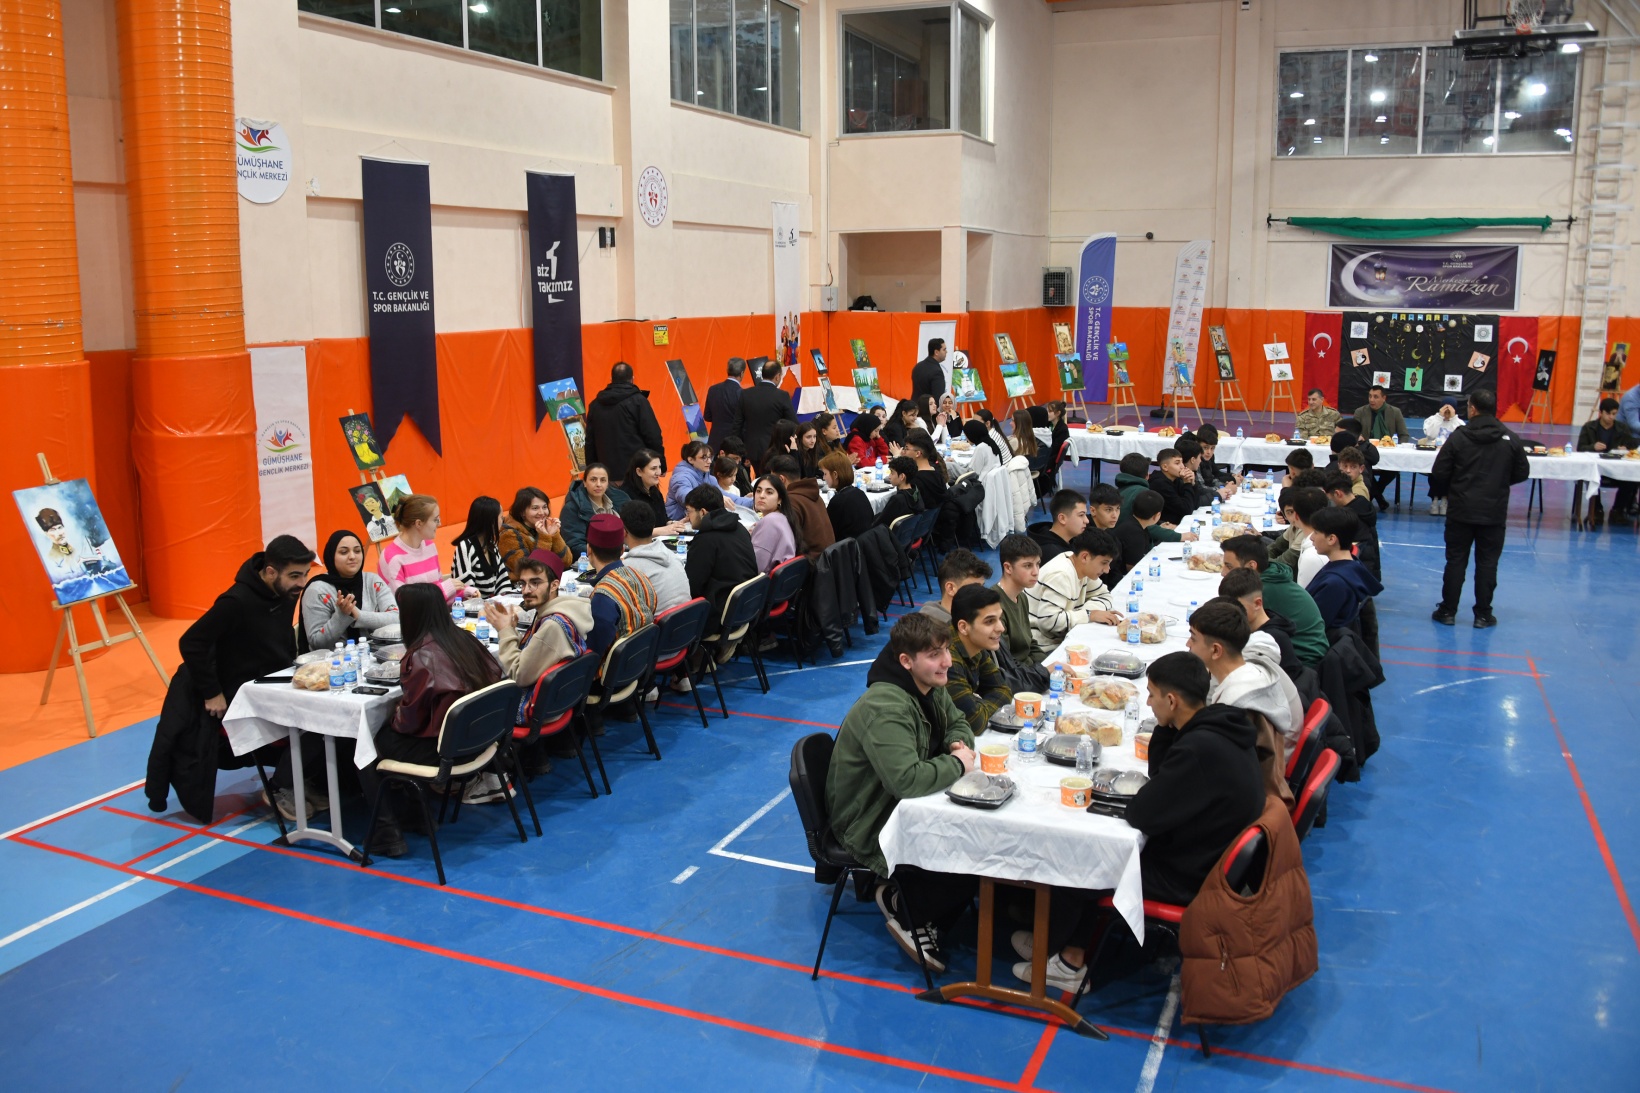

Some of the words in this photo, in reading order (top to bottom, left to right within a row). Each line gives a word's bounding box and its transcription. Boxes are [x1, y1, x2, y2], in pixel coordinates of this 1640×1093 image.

[237, 154, 284, 170] ÜMÜŞHANE
[237, 168, 258, 180] NÇLİK
[259, 171, 288, 181] MERKEZİ
[537, 263, 550, 277] BİZ
[1404, 275, 1511, 297] Ramazan
[372, 291, 386, 301] T.C.
[387, 290, 418, 302] GENÇLİK
[420, 290, 429, 300] VE
[373, 303, 392, 313] SPOR
[393, 301, 430, 313] BAKANLIĞI
[1092, 351, 1099, 361] VE
[262, 453, 303, 466] GÜMÜŞHANE
[258, 466, 284, 477] GENÇLİK
[284, 463, 309, 473] MERKEZİ
